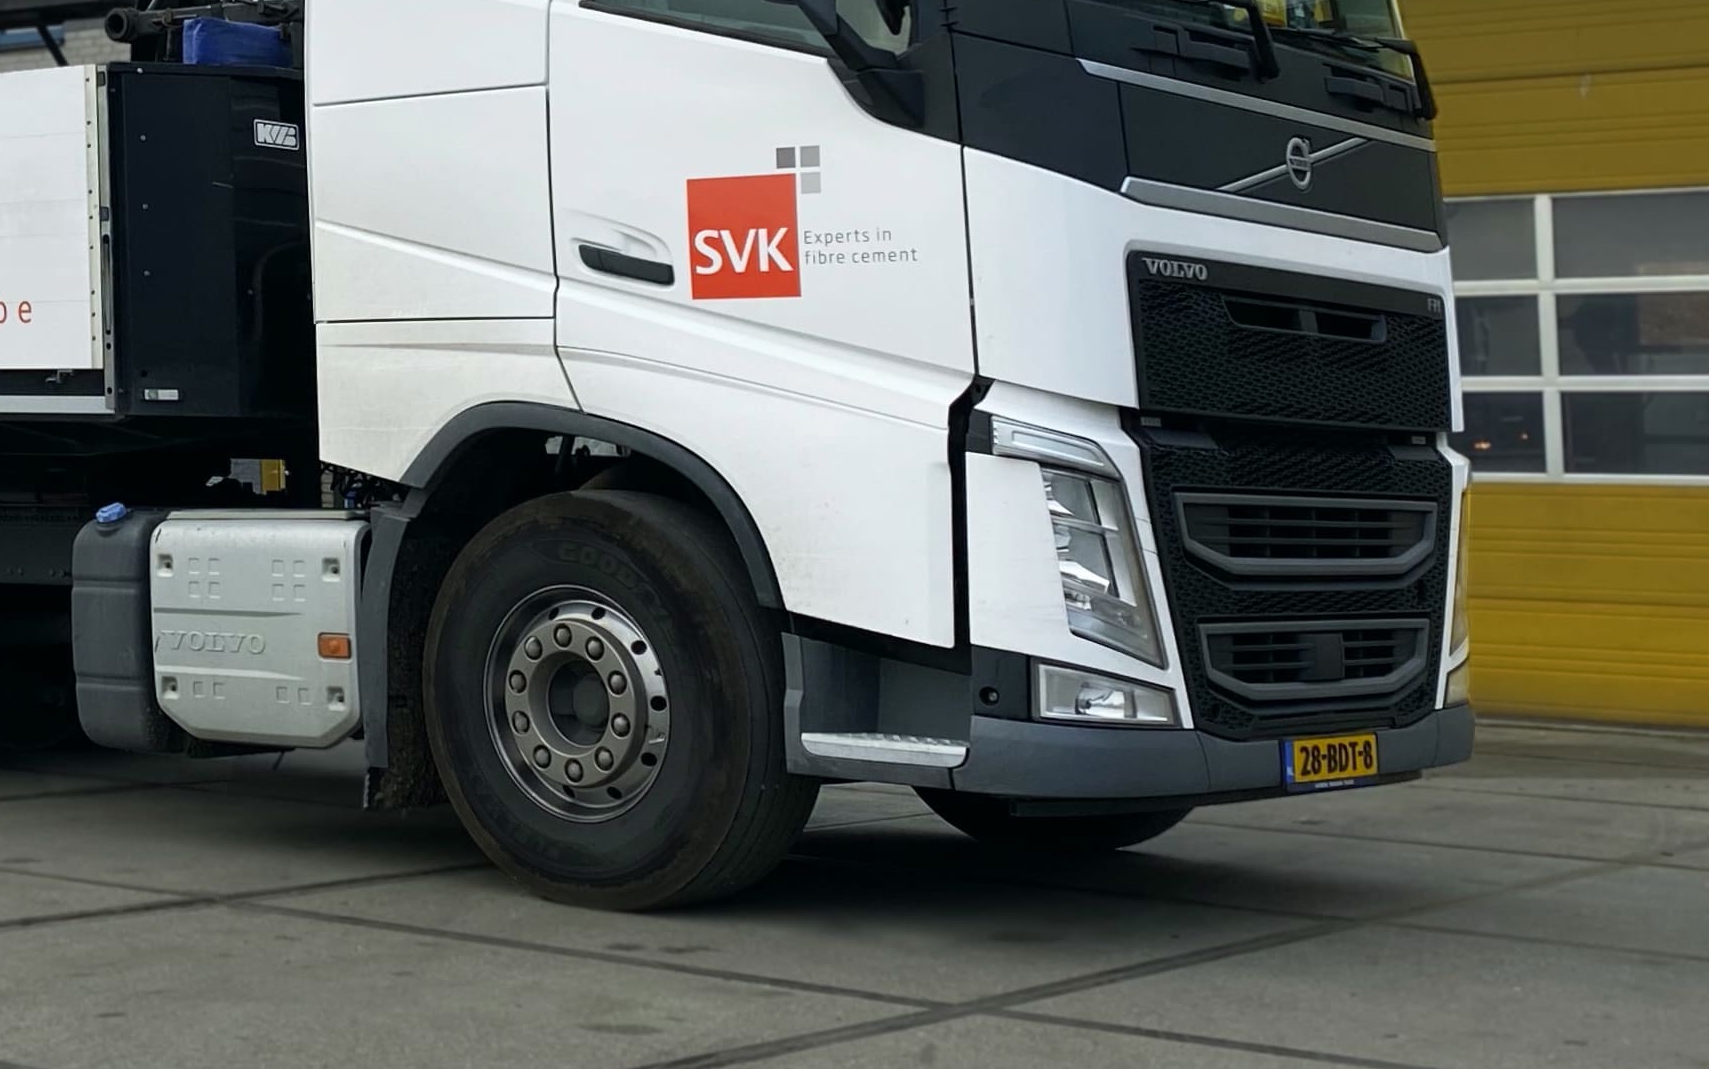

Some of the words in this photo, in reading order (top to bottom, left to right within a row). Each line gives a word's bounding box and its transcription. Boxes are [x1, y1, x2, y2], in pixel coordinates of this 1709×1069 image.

[803, 229, 871, 248] Experts
[876, 227, 892, 243] in
[694, 227, 794, 276] SVK
[804, 250, 846, 265] fibre
[851, 247, 919, 264] cement
[1142, 257, 1209, 282] VOLVO
[161, 629, 267, 656] VOLVO
[1299, 740, 1374, 777] 28-BDT-8
